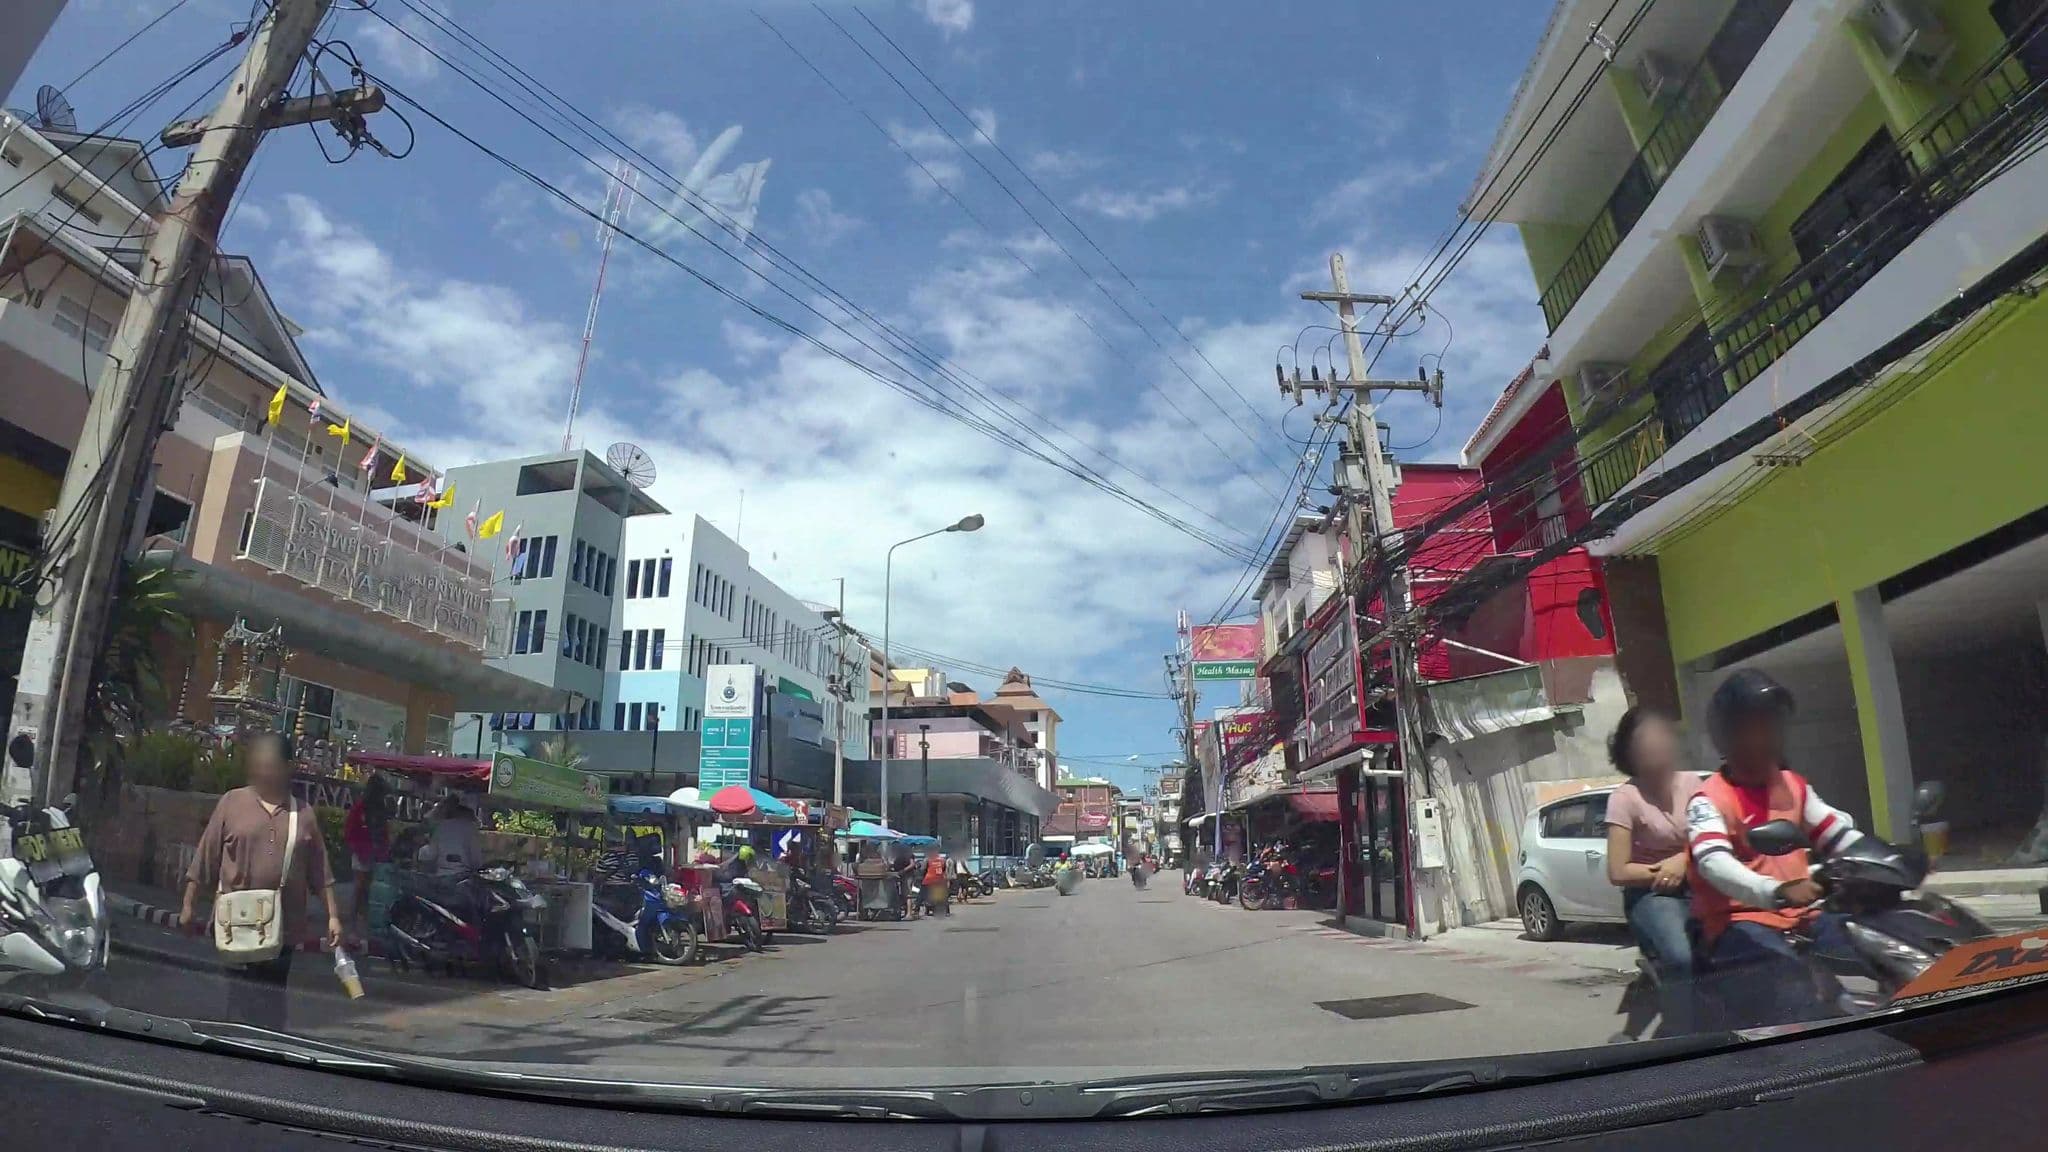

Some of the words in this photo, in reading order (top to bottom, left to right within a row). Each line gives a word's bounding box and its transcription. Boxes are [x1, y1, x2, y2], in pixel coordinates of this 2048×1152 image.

[285, 540, 371, 592] PATTAYA
[1196, 666, 1223, 675] Health
[1225, 666, 1256, 677] Massag
